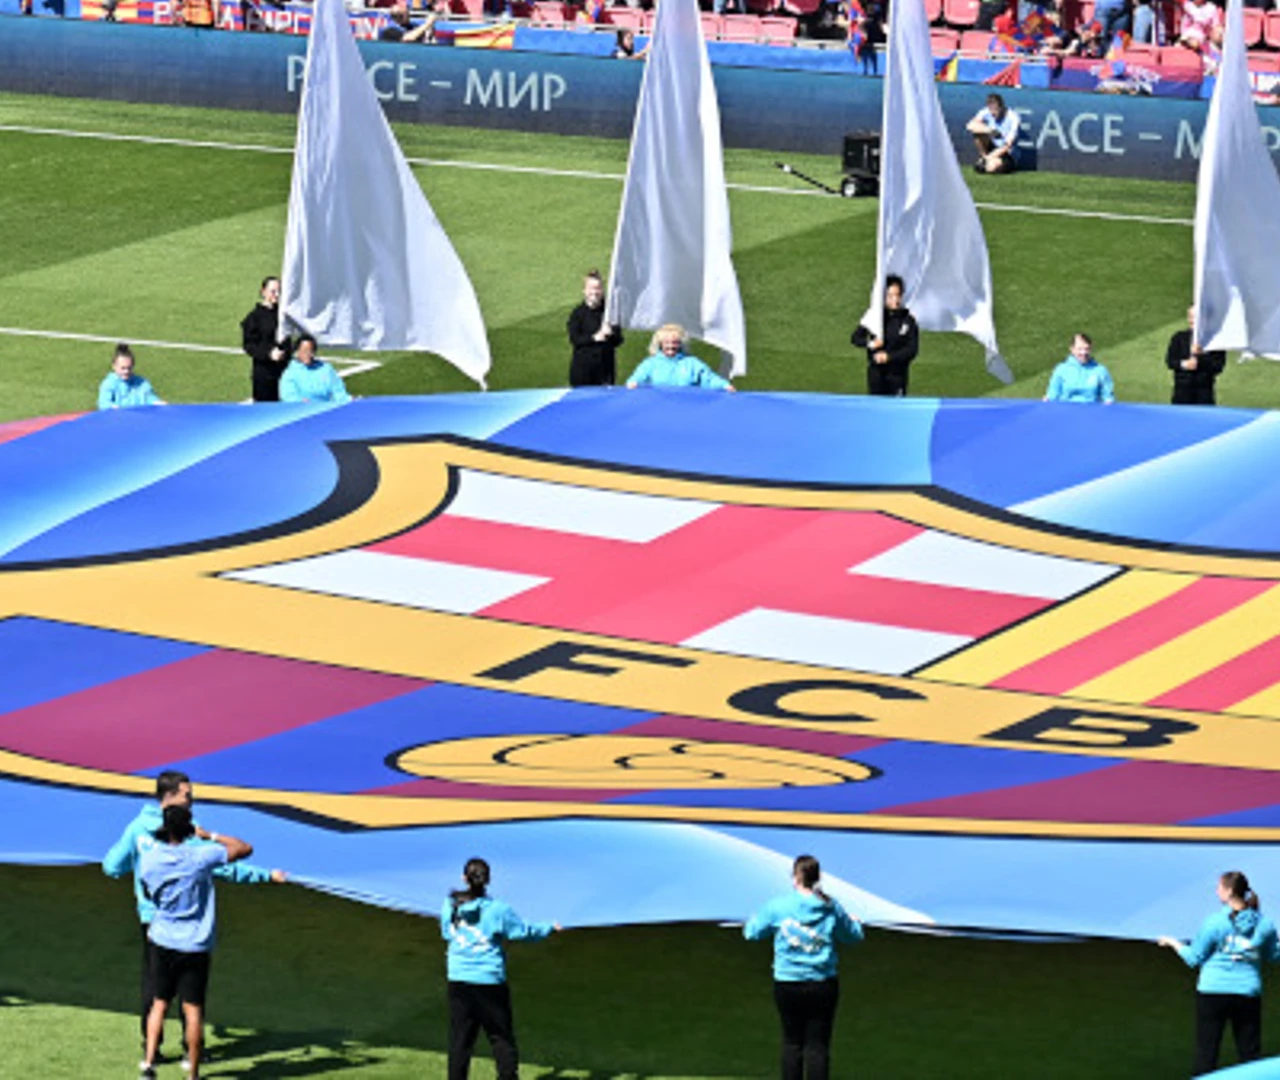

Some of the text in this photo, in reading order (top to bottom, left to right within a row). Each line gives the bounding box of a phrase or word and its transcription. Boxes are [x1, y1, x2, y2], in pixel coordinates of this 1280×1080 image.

[286, 54, 419, 103] PCE
[463, 67, 568, 112] МИР
[1018, 108, 1126, 155] EACE
